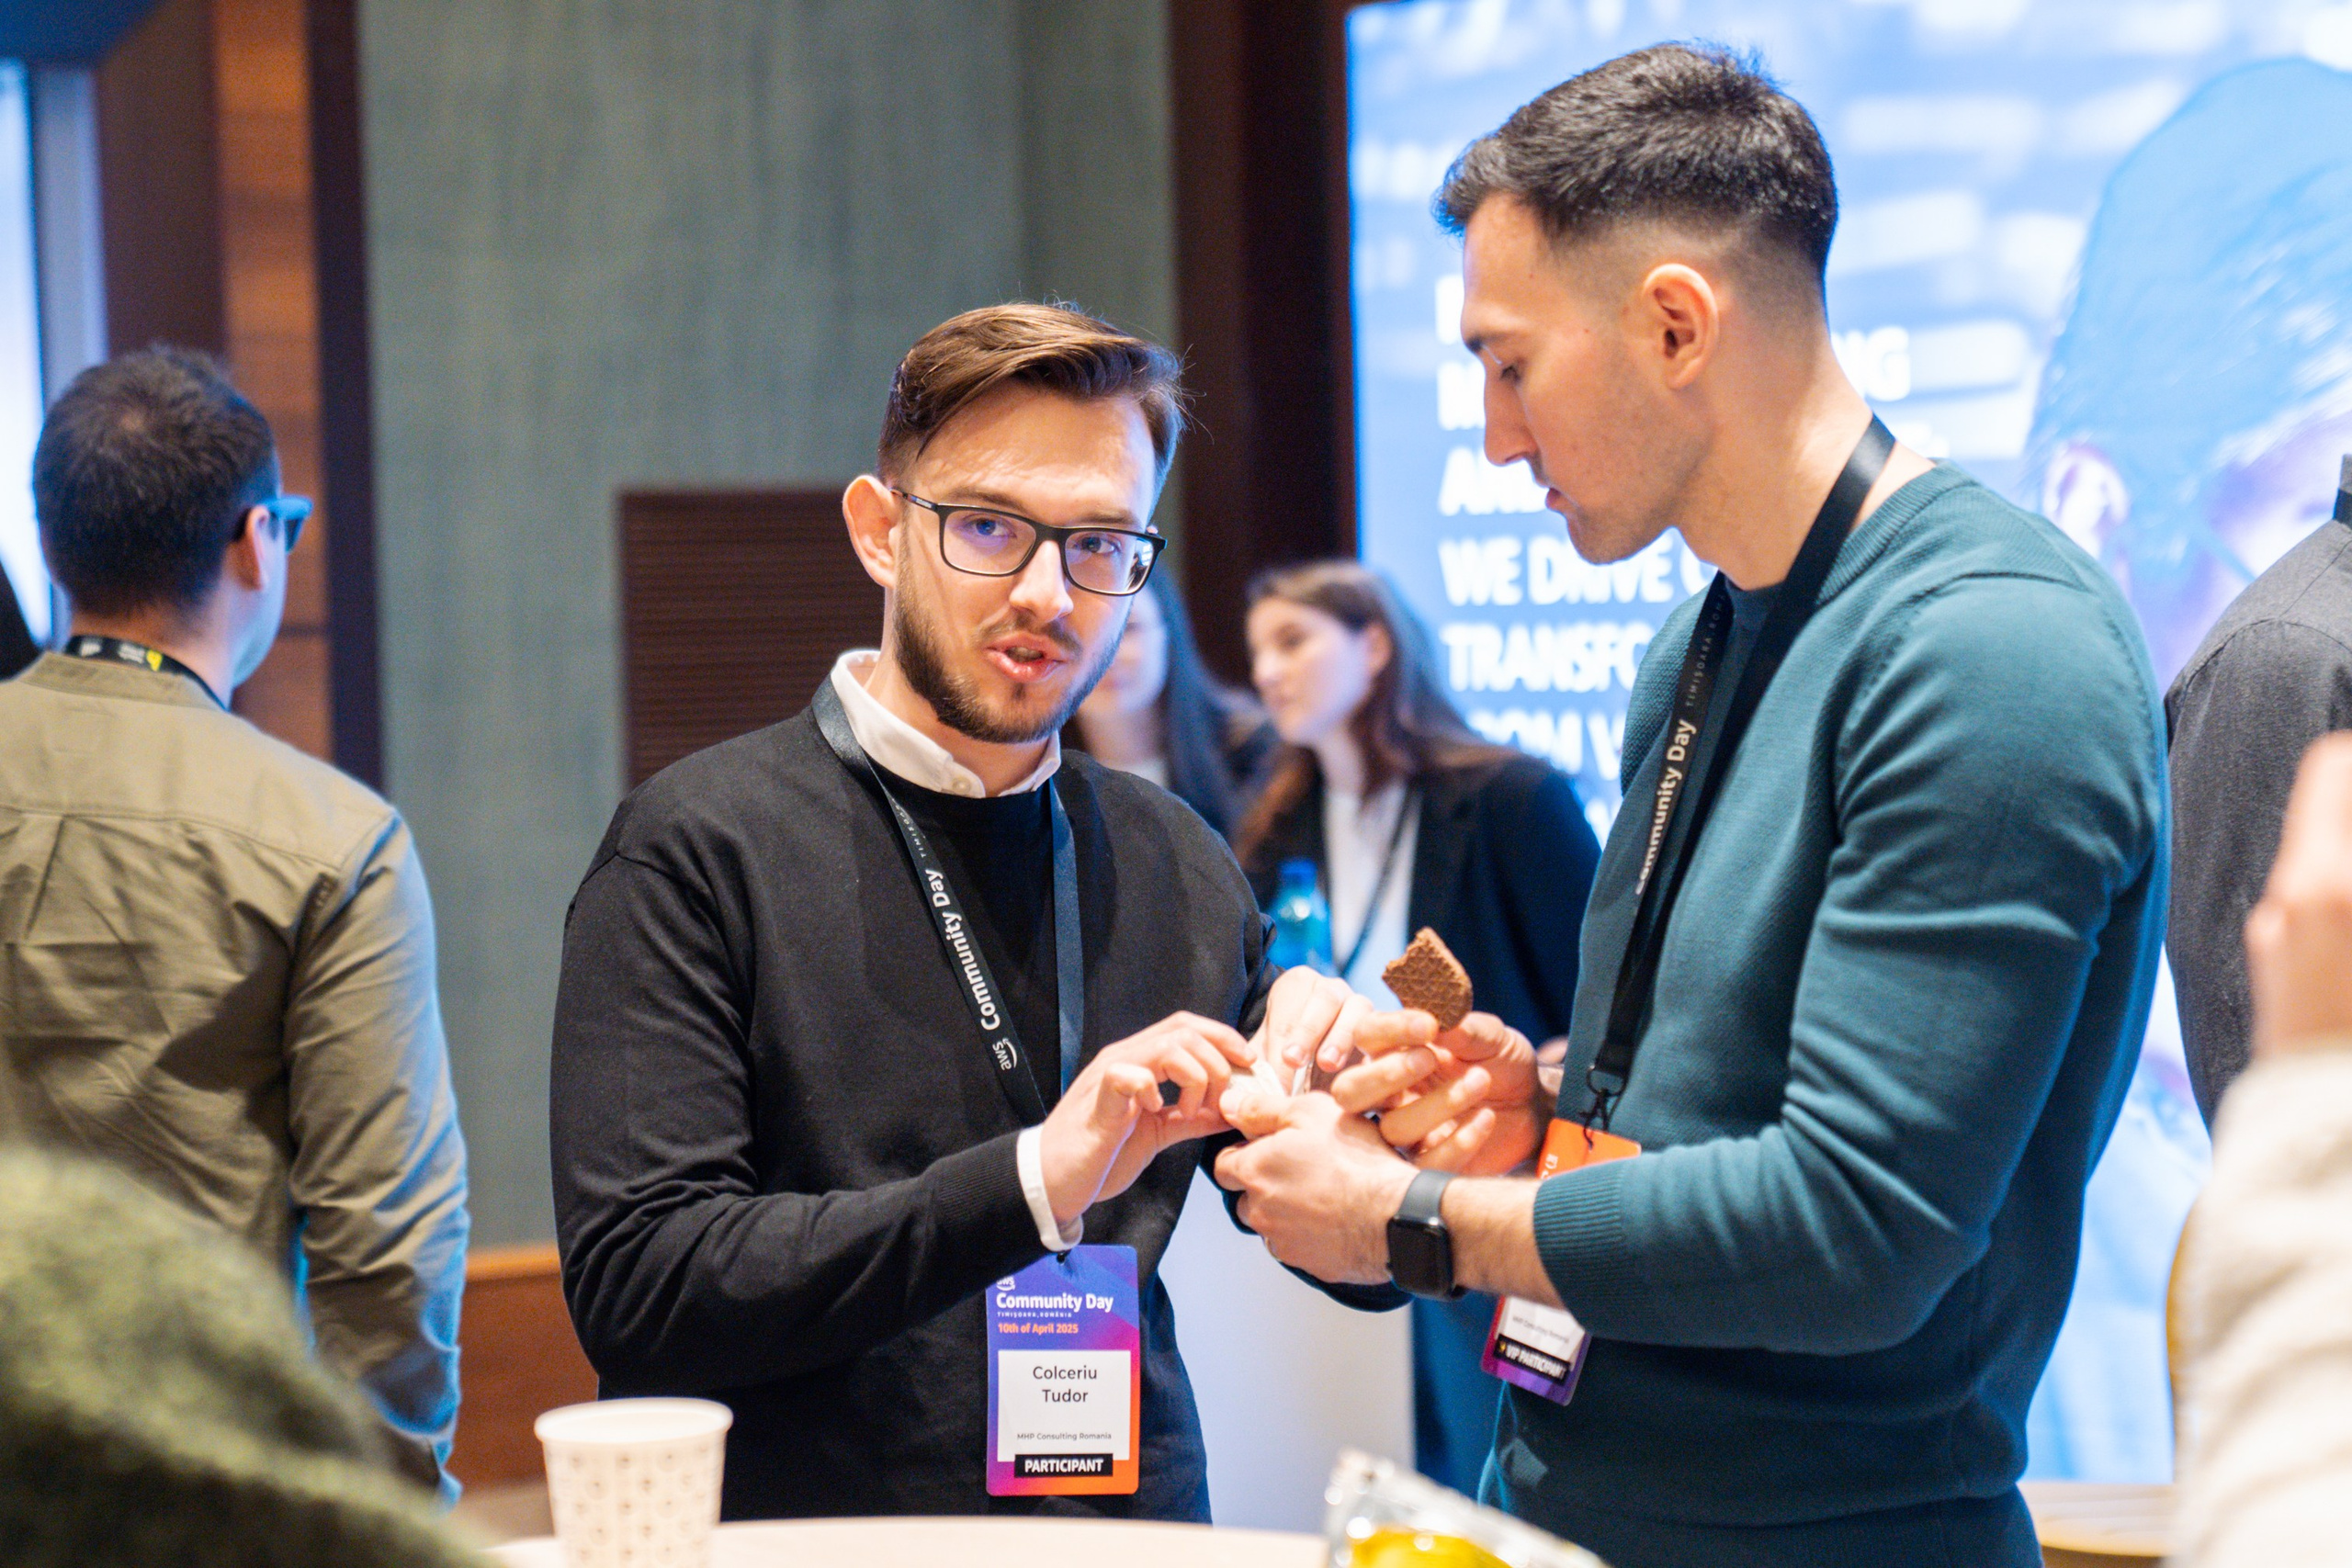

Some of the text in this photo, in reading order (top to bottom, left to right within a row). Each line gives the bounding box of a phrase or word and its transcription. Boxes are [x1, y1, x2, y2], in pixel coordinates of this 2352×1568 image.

[1439, 536, 1522, 606] WE
[1440, 622, 1656, 693] TRANSFO
[1667, 719, 1697, 761] Day
[924, 867, 951, 908] Day
[941, 909, 1001, 1032] Community
[996, 1292, 1114, 1312] Community Day
[998, 1323, 1079, 1335] 10th of April 2025
[1033, 1365, 1097, 1380] Colceriu
[1042, 1389, 1089, 1403] Tudor
[1036, 1432, 1078, 1441] Consulting
[1079, 1432, 1112, 1440] Romania
[1024, 1459, 1103, 1472] PARTICIPANT
